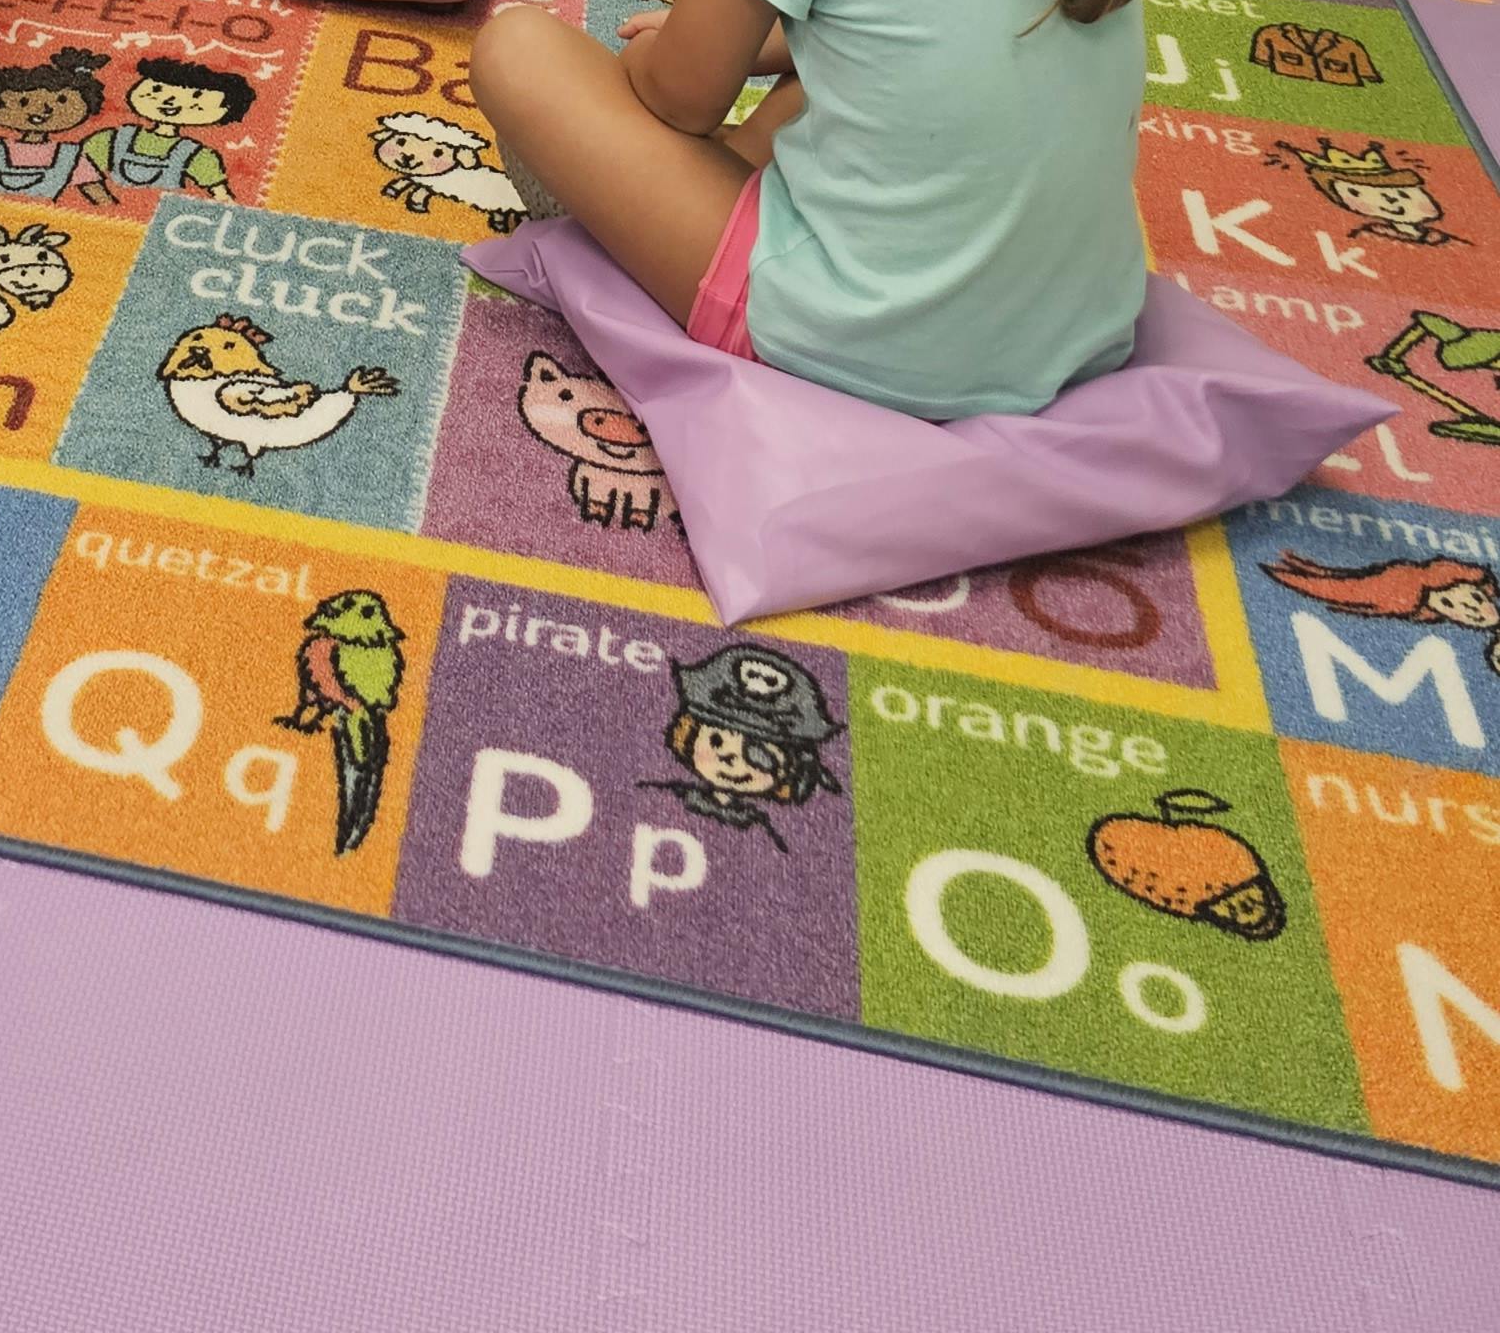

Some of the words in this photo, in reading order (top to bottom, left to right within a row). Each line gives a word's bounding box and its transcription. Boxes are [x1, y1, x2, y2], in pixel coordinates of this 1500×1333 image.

[1145, 34, 1188, 84] J
[1211, 58, 1242, 102] j
[163, 208, 395, 283] cluck
[1181, 188, 1297, 267] K
[1314, 230, 1379, 279] k
[189, 266, 432, 337] cluck
[75, 531, 320, 605] quetzal
[457, 603, 668, 675] pirate
[1289, 610, 1487, 749] M
[40, 649, 204, 803] Q
[222, 741, 302, 833] q
[869, 683, 1170, 779] orange
[457, 746, 596, 880] P
[628, 821, 709, 908] p
[905, 848, 1092, 1001] O
[1117, 961, 1205, 1034] o
